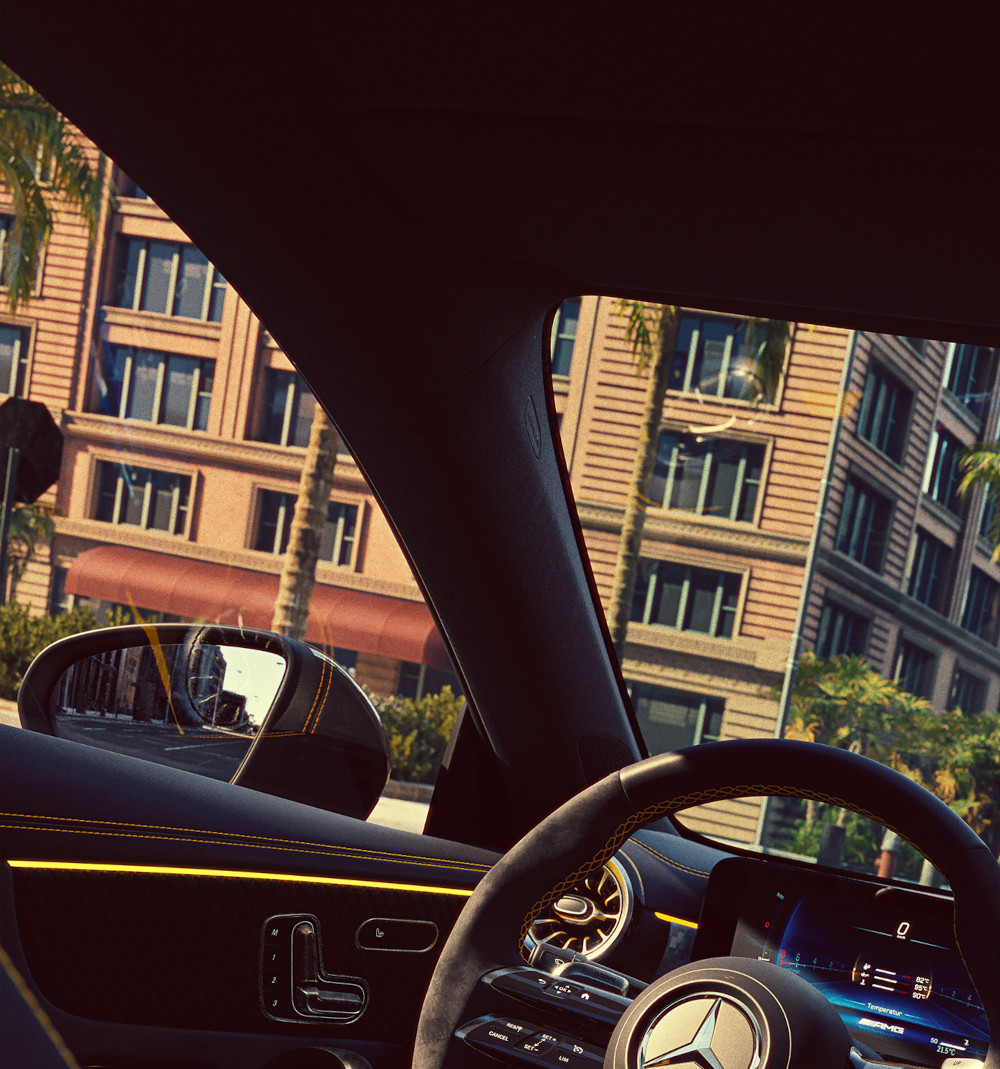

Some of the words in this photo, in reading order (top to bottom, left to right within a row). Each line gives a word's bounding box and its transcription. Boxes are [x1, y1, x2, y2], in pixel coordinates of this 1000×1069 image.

[896, 921, 910, 936] 0
[594, 970, 616, 983] DOWN
[867, 1003, 903, 1016] Temperatur
[488, 1030, 509, 1042] CANCEL
[930, 1037, 939, 1045] 50
[558, 1055, 569, 1063] LIM
